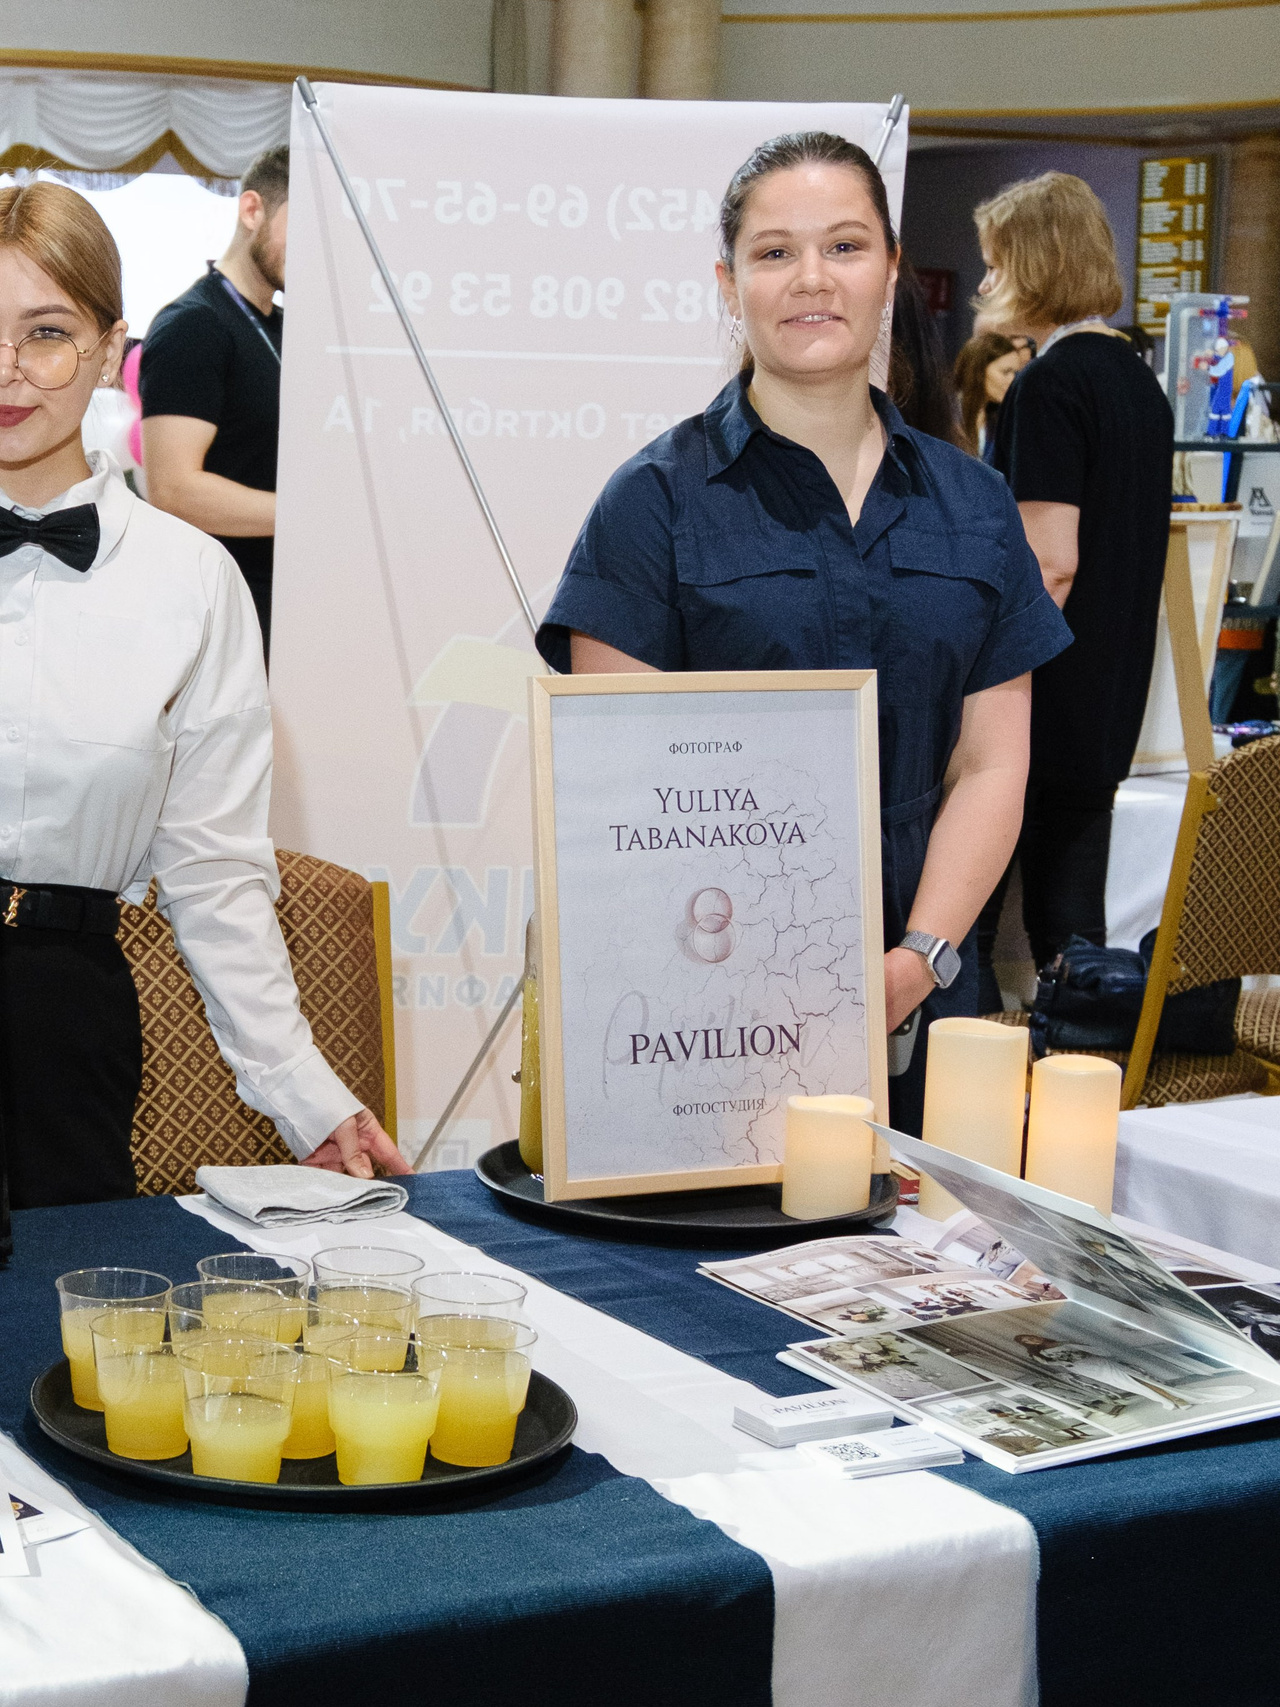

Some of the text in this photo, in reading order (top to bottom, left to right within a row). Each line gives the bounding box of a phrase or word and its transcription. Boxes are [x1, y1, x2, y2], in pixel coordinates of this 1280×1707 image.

[669, 741, 742, 755] ФОТОГРАФ
[653, 787, 760, 814] YULIYA
[609, 822, 808, 852] TABANAKOVA
[629, 1022, 802, 1066] PAVILION
[672, 1098, 766, 1117] ФОТОСТУДИЯ
[773, 1399, 848, 1414] PAVILION
